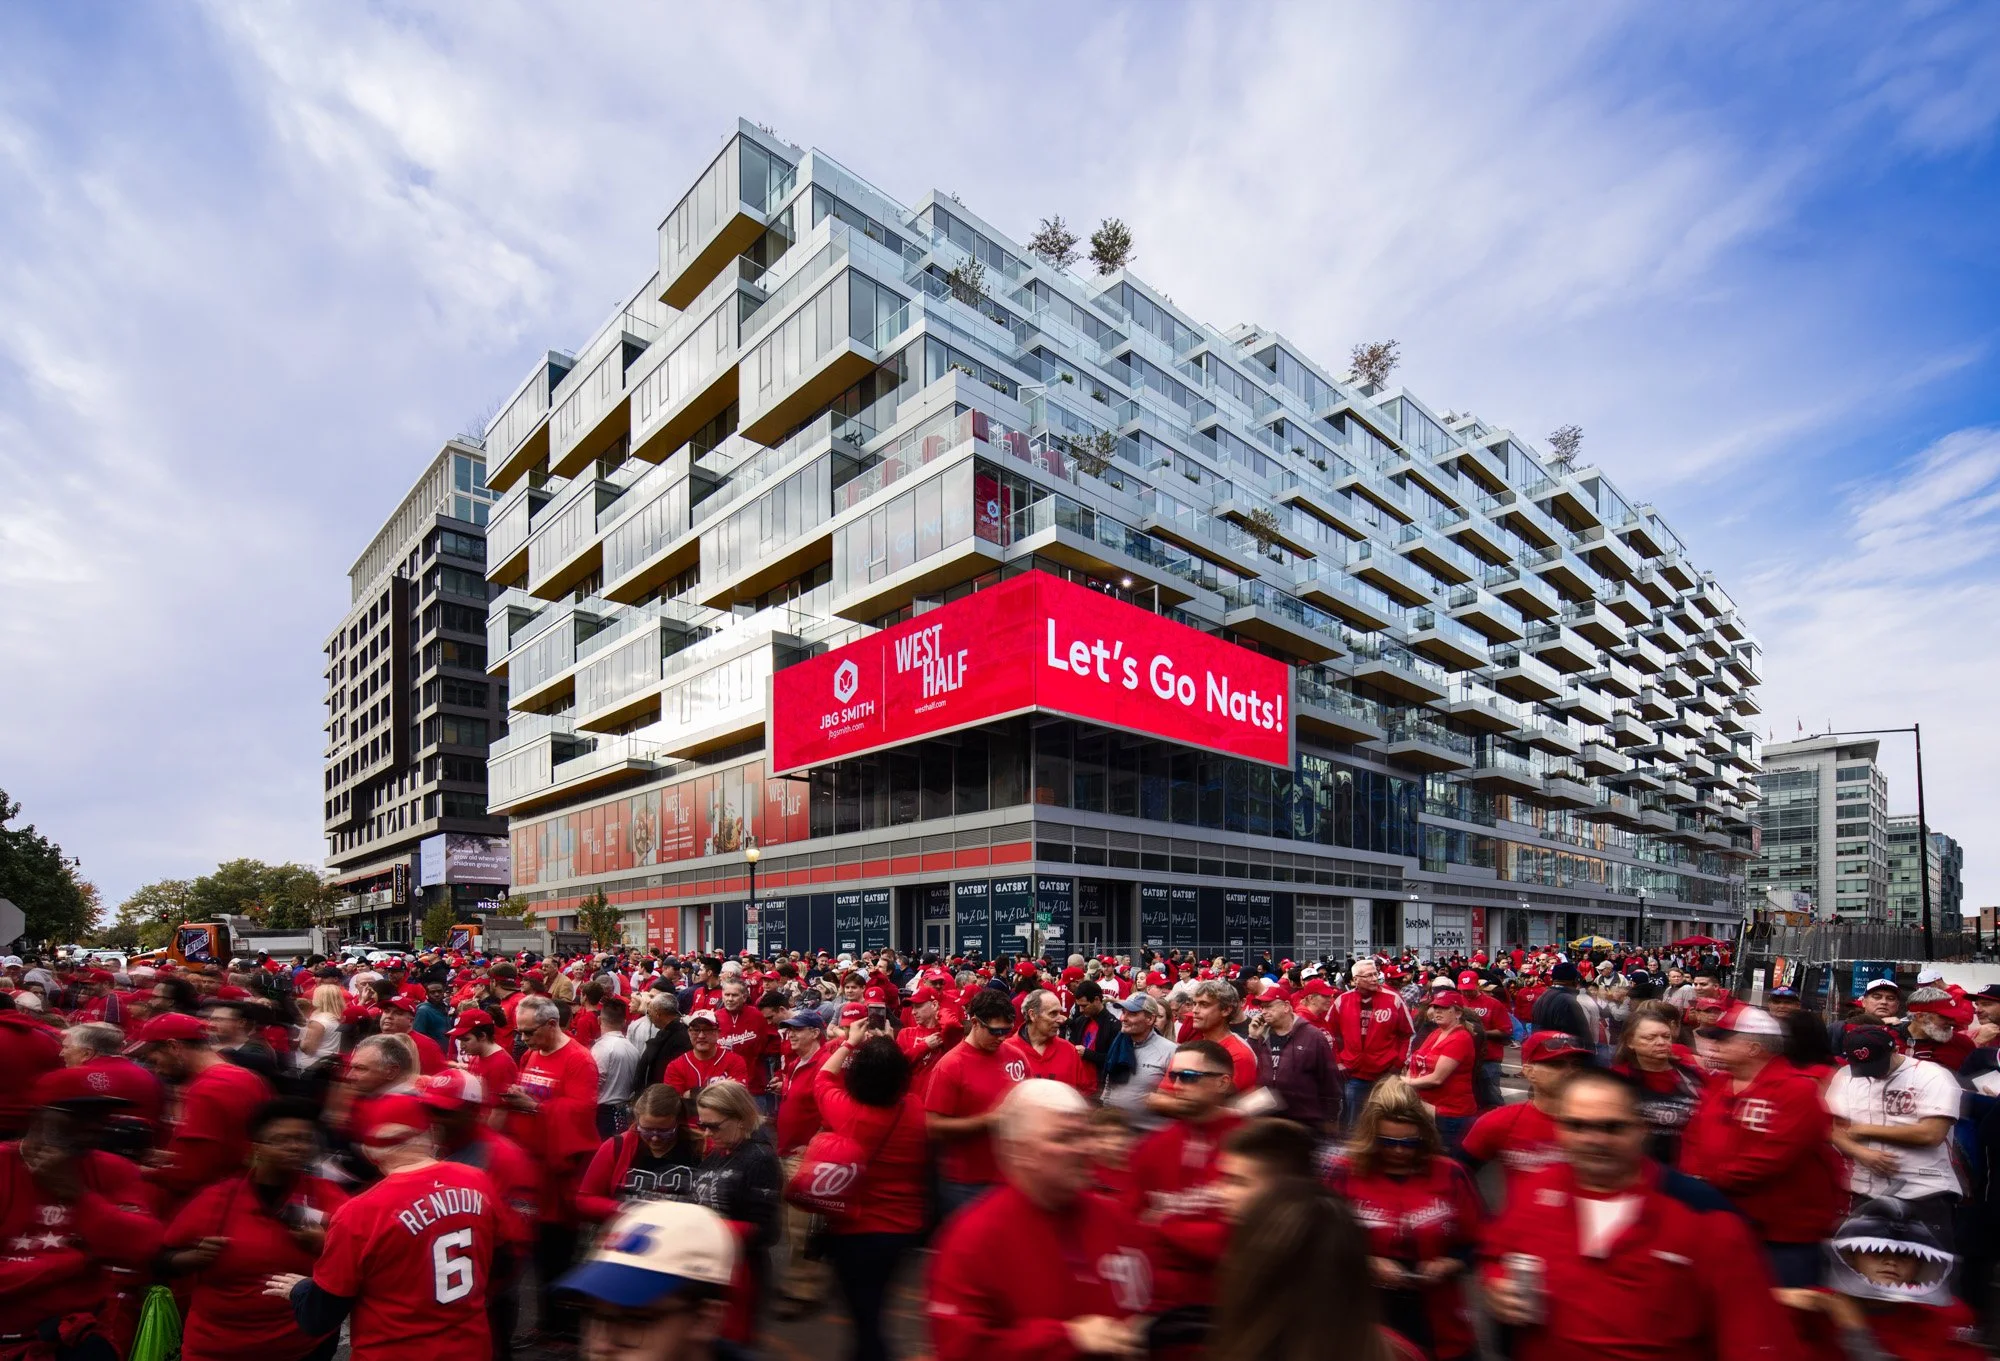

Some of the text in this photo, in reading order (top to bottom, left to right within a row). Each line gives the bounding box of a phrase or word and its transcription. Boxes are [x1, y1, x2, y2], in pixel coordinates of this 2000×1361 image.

[894, 623, 943, 674] WEST
[922, 649, 968, 699] HALF
[1047, 618, 1283, 733] Let's Go Nats!
[914, 700, 947, 714] westhalf.com
[819, 700, 875, 730] JBG SMITH
[828, 722, 865, 740] jbgsmith.com
[781, 795, 801, 817] HALF
[957, 884, 988, 895] GATSBY
[995, 881, 1028, 892] GATSBY
[1039, 881, 1070, 891] GATSBY
[1142, 887, 1168, 897] GATSBY
[837, 895, 860, 905] GATSBY
[864, 893, 888, 902] GATSBY
[1172, 890, 1196, 899] GATSBY
[1226, 893, 1247, 902] GATSBY
[1250, 895, 1270, 903] GATSBY
[766, 901, 786, 909] GATSBY
[1374, 1007, 1392, 1023] W
[1005, 1060, 1025, 1081] W
[811, 1162, 857, 1196] W
[814, 1199, 845, 1208] TOYOTA
[399, 1188, 483, 1235] RENDON
[433, 1227, 474, 1304] 6
